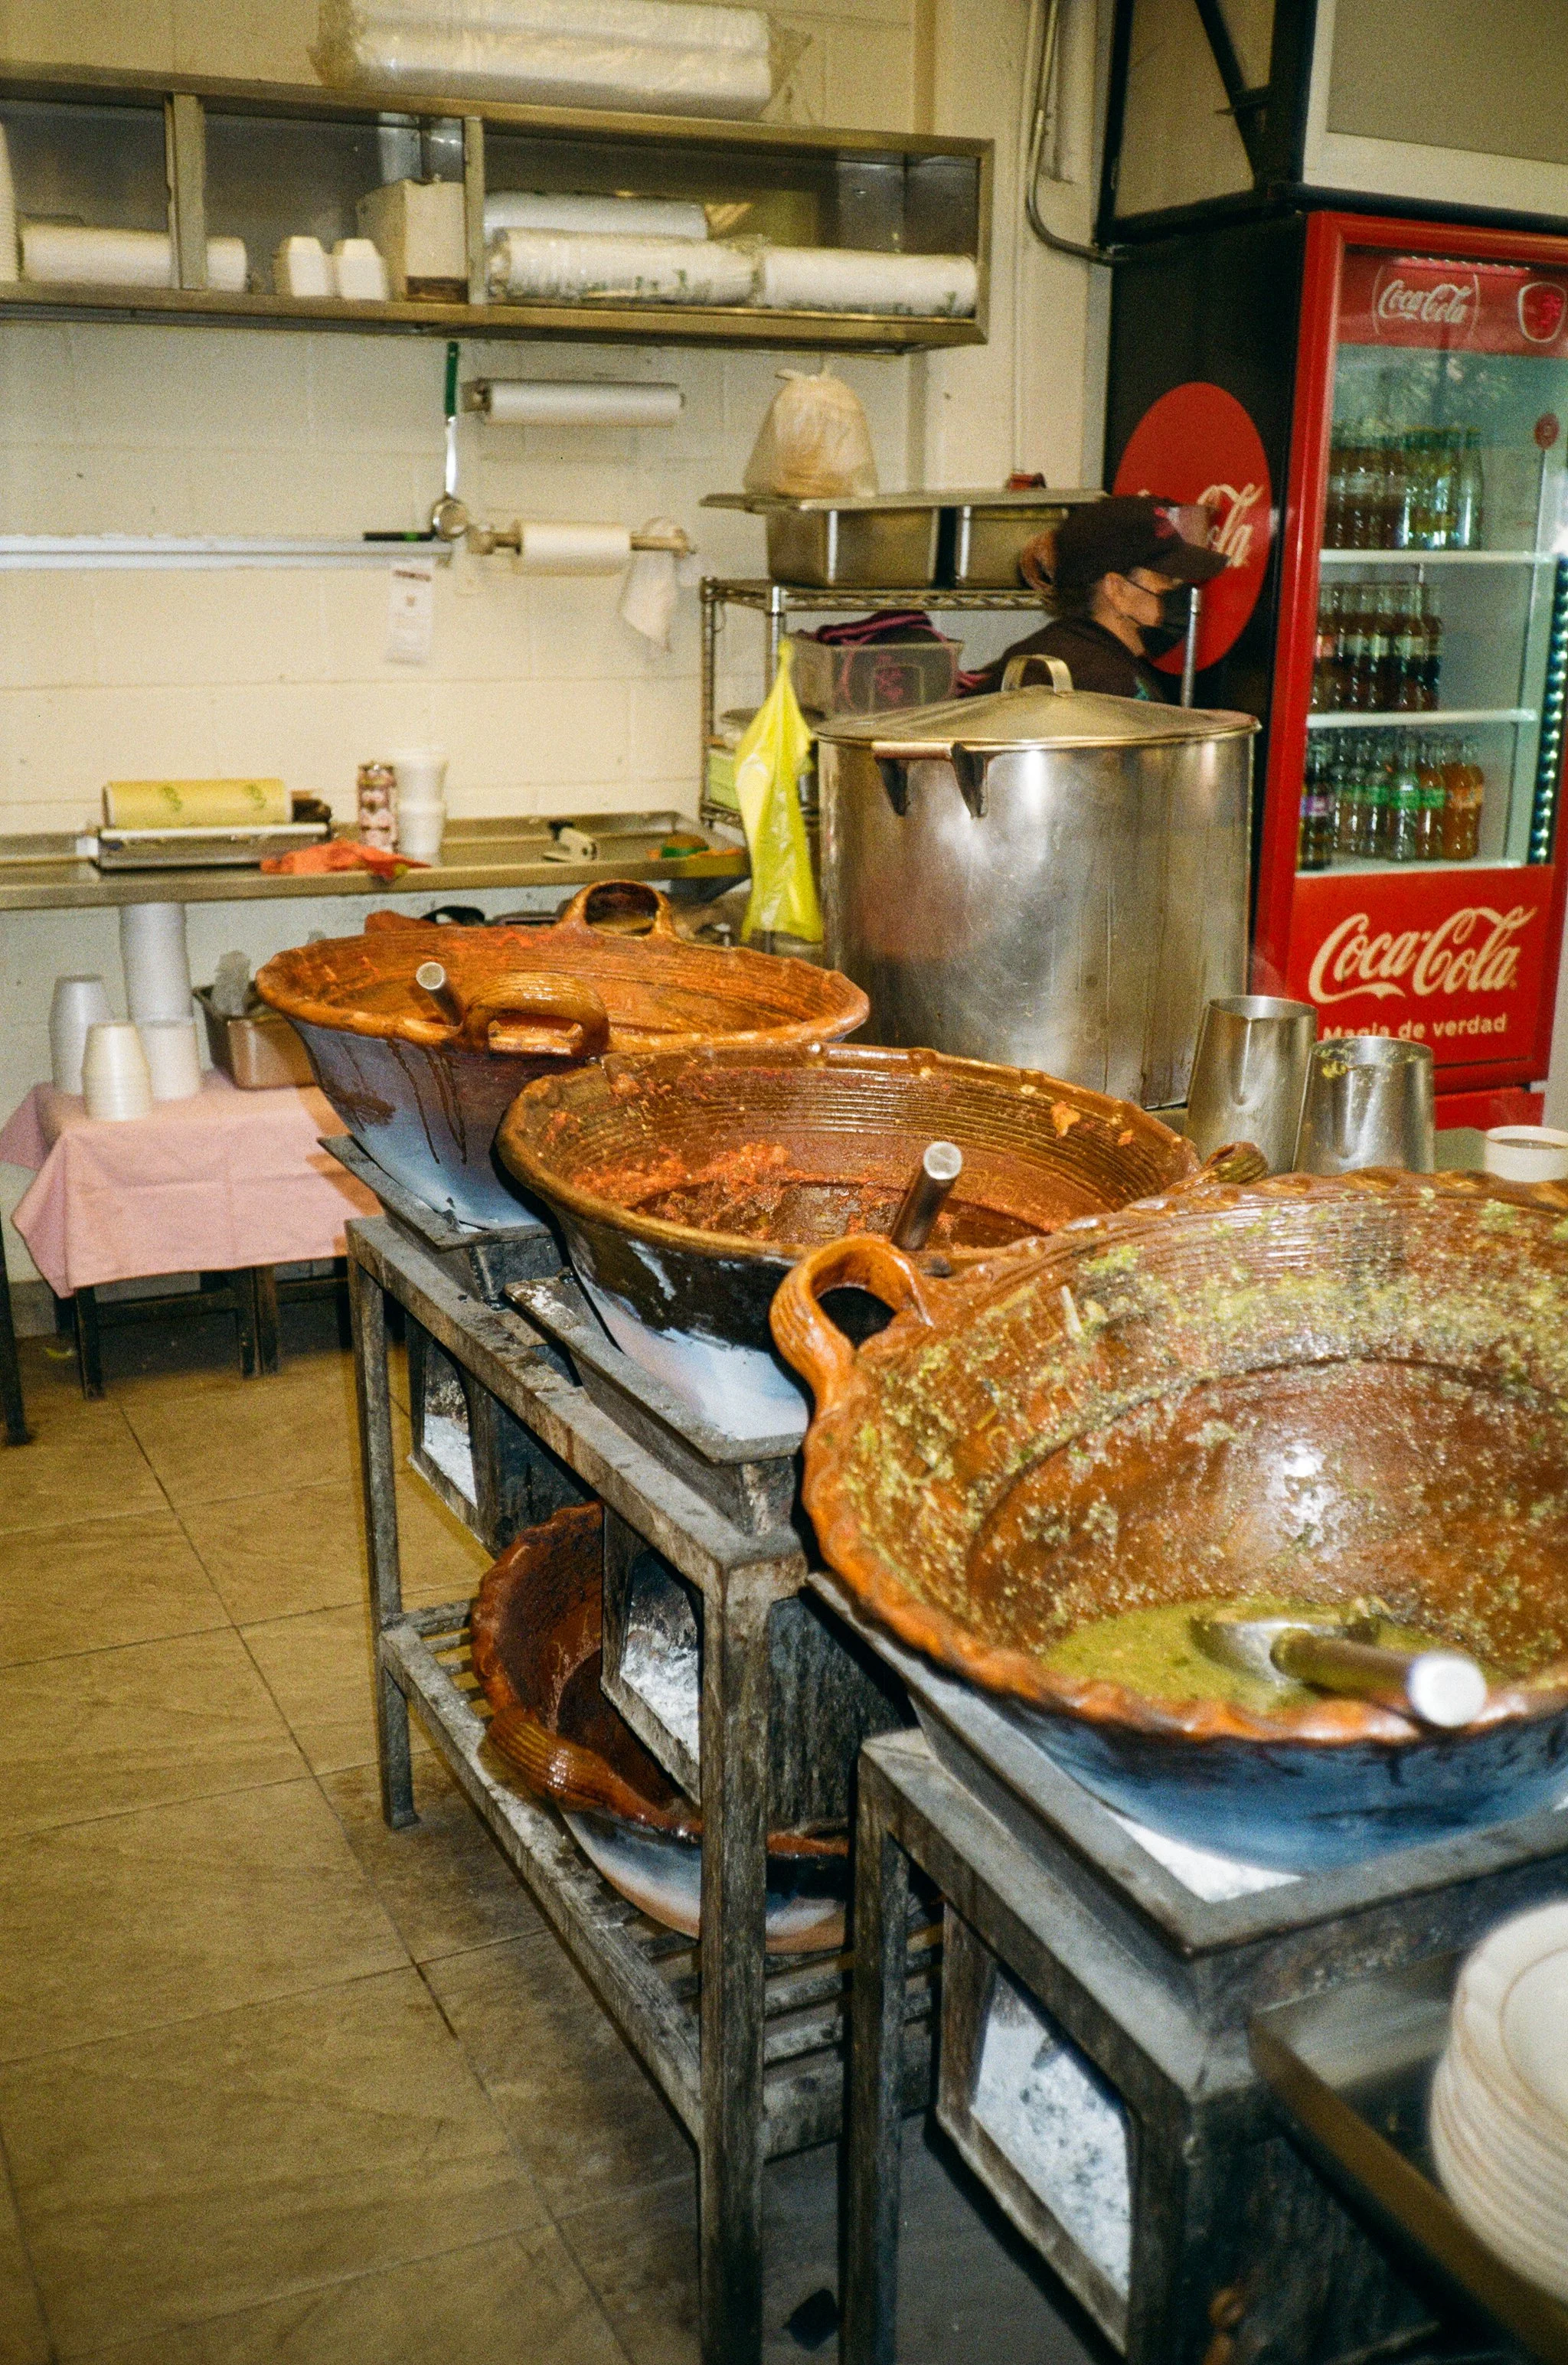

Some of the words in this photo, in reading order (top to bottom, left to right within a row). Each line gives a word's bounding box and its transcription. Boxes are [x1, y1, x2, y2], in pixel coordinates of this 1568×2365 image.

[1308, 905, 1537, 1004] Coca-Cola
[1398, 1019, 1425, 1040] de
[1432, 1012, 1508, 1037] verdad
